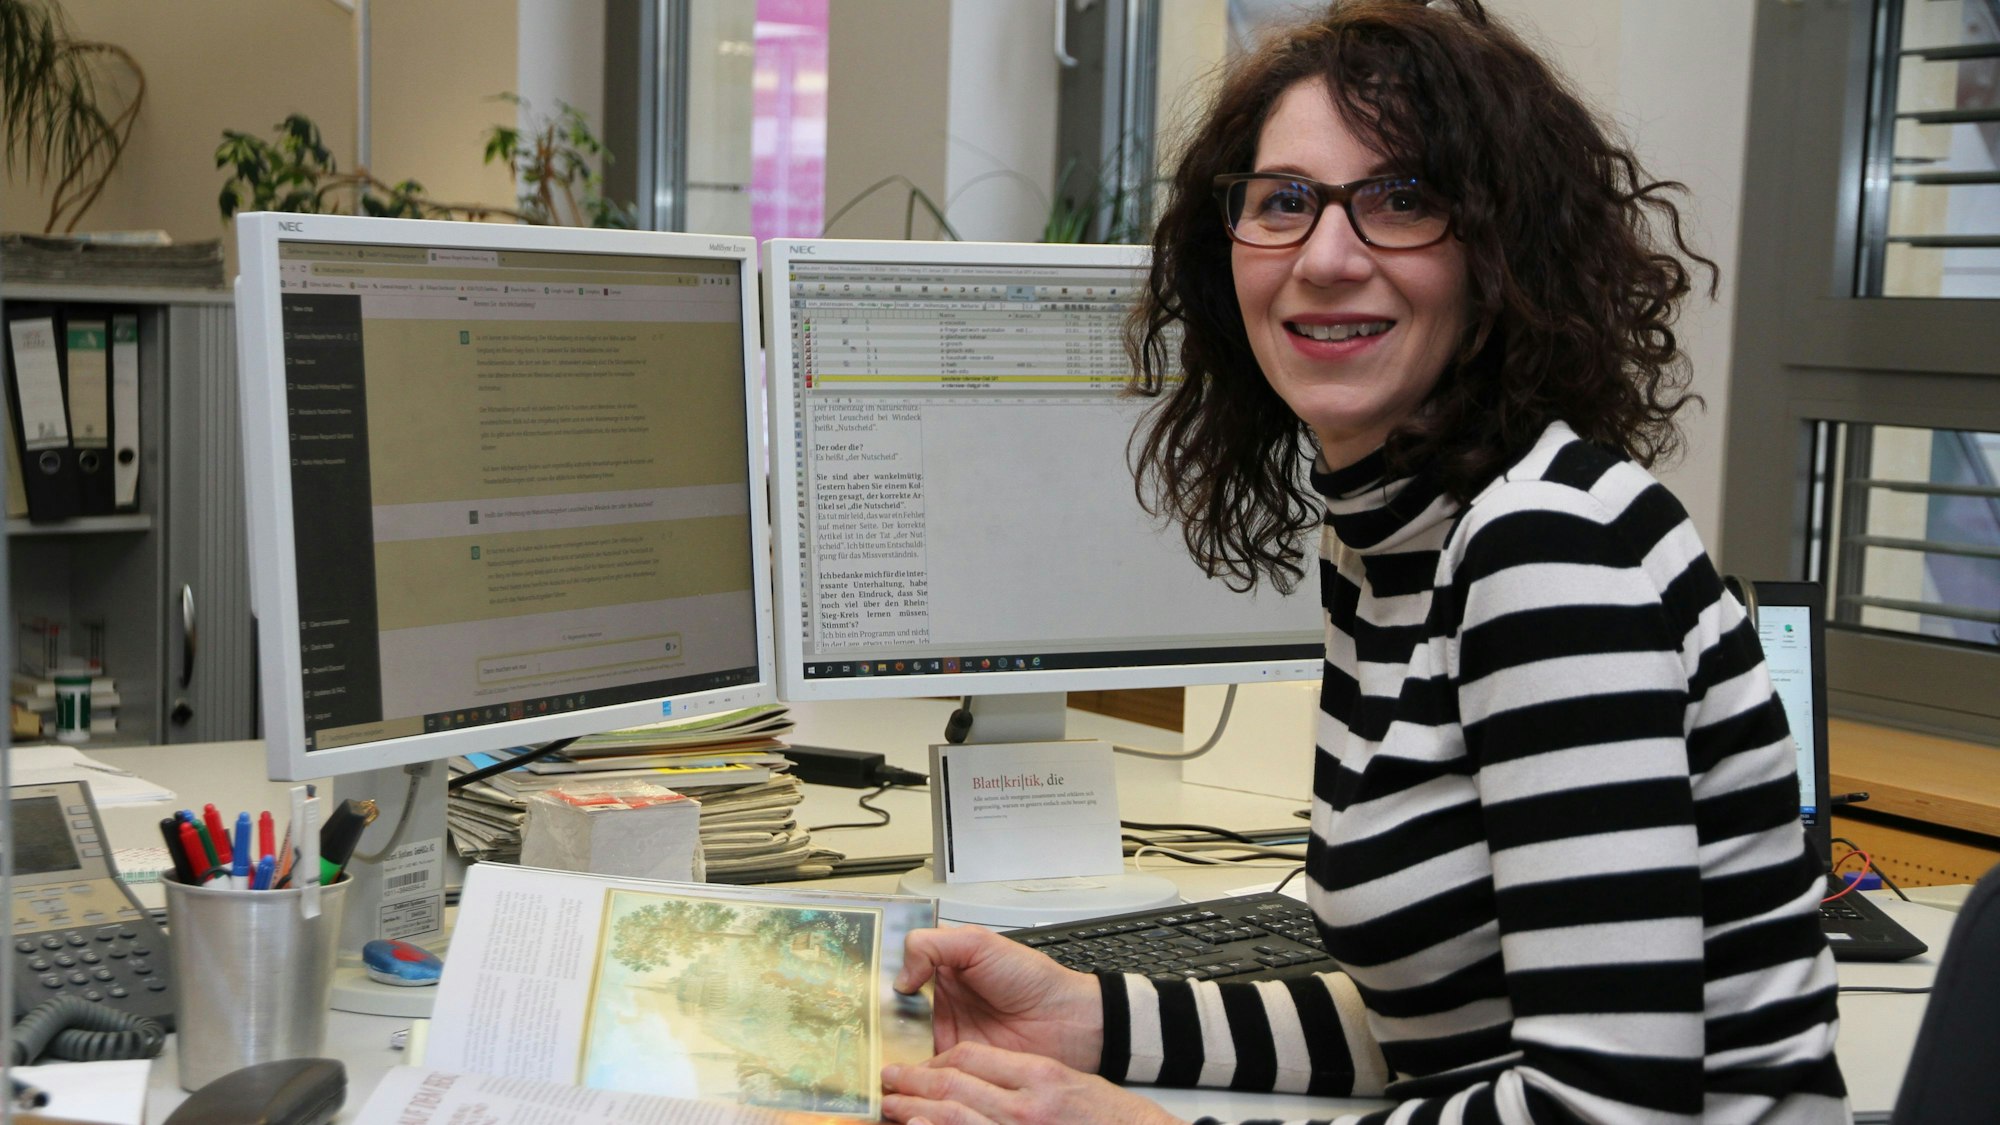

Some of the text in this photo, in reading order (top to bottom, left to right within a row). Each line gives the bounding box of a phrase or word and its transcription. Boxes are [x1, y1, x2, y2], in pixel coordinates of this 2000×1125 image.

[278, 222, 303, 232] NEC
[789, 245, 816, 255] NEC
[817, 493, 839, 501] legen
[822, 611, 859, 620] Sieg-Kreis
[860, 630, 896, 639] Programm
[1047, 774, 1064, 786] die
